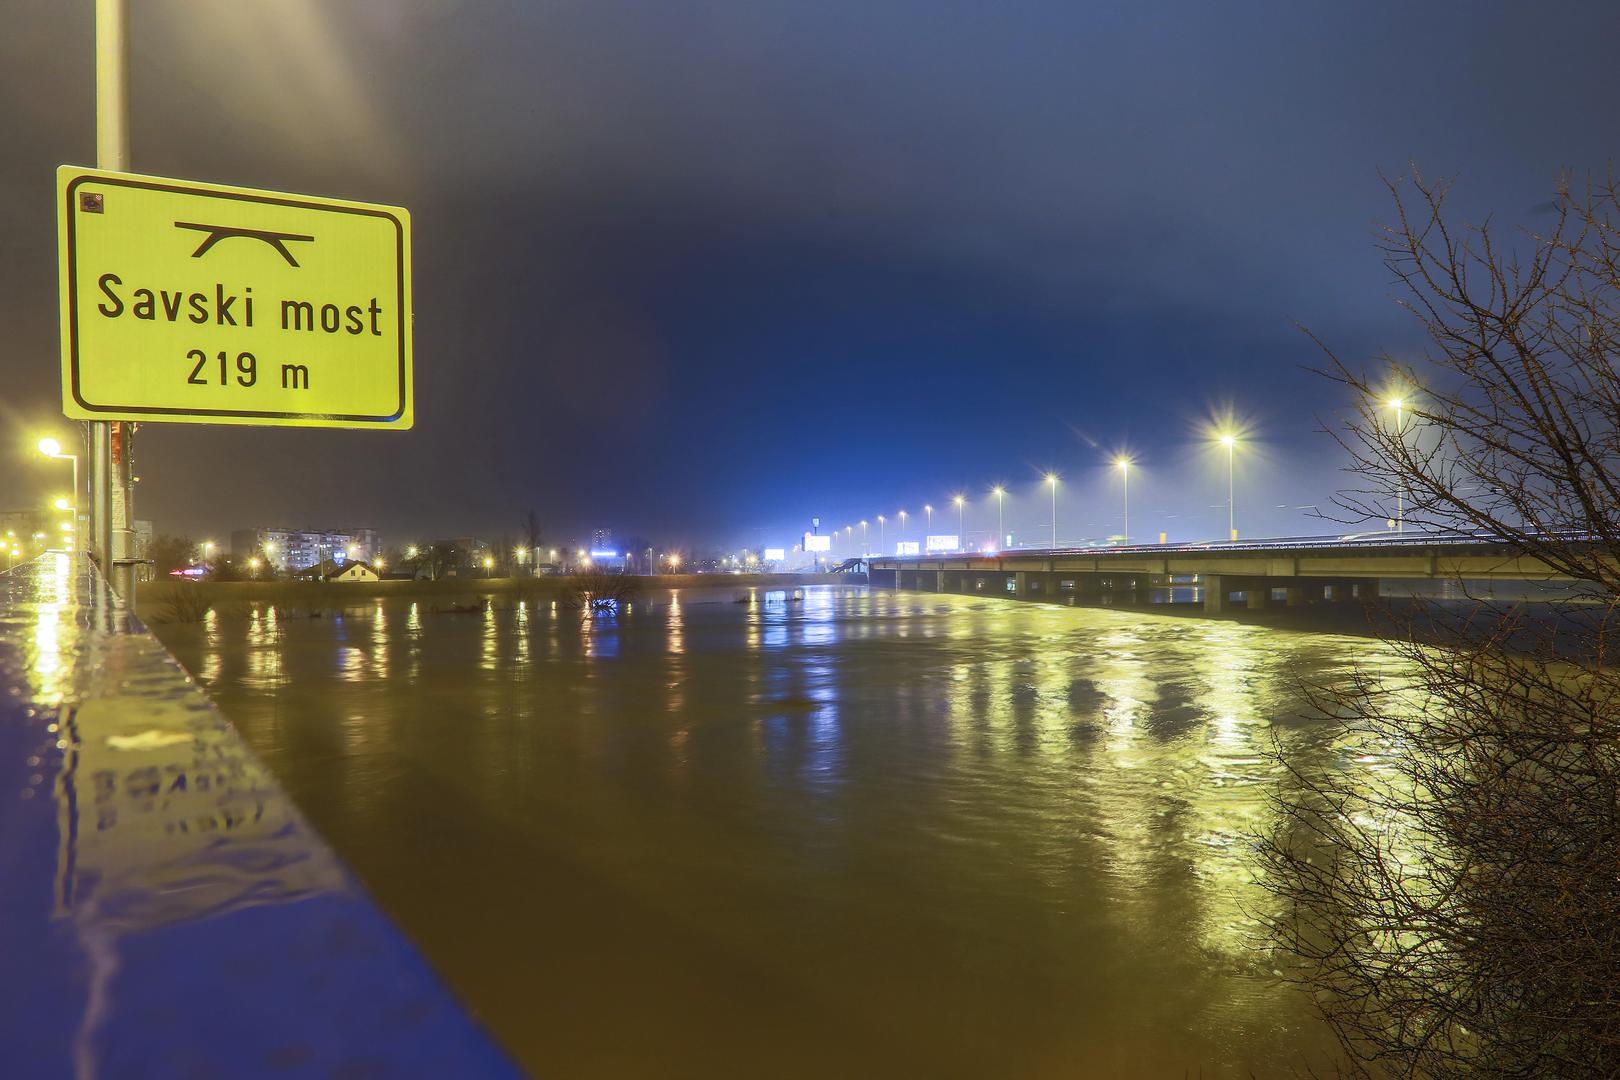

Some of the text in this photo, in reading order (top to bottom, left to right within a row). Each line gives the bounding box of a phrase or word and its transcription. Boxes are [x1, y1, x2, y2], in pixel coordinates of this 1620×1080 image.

[97, 273, 382, 336] Savski most
[186, 349, 309, 390] 219 m
